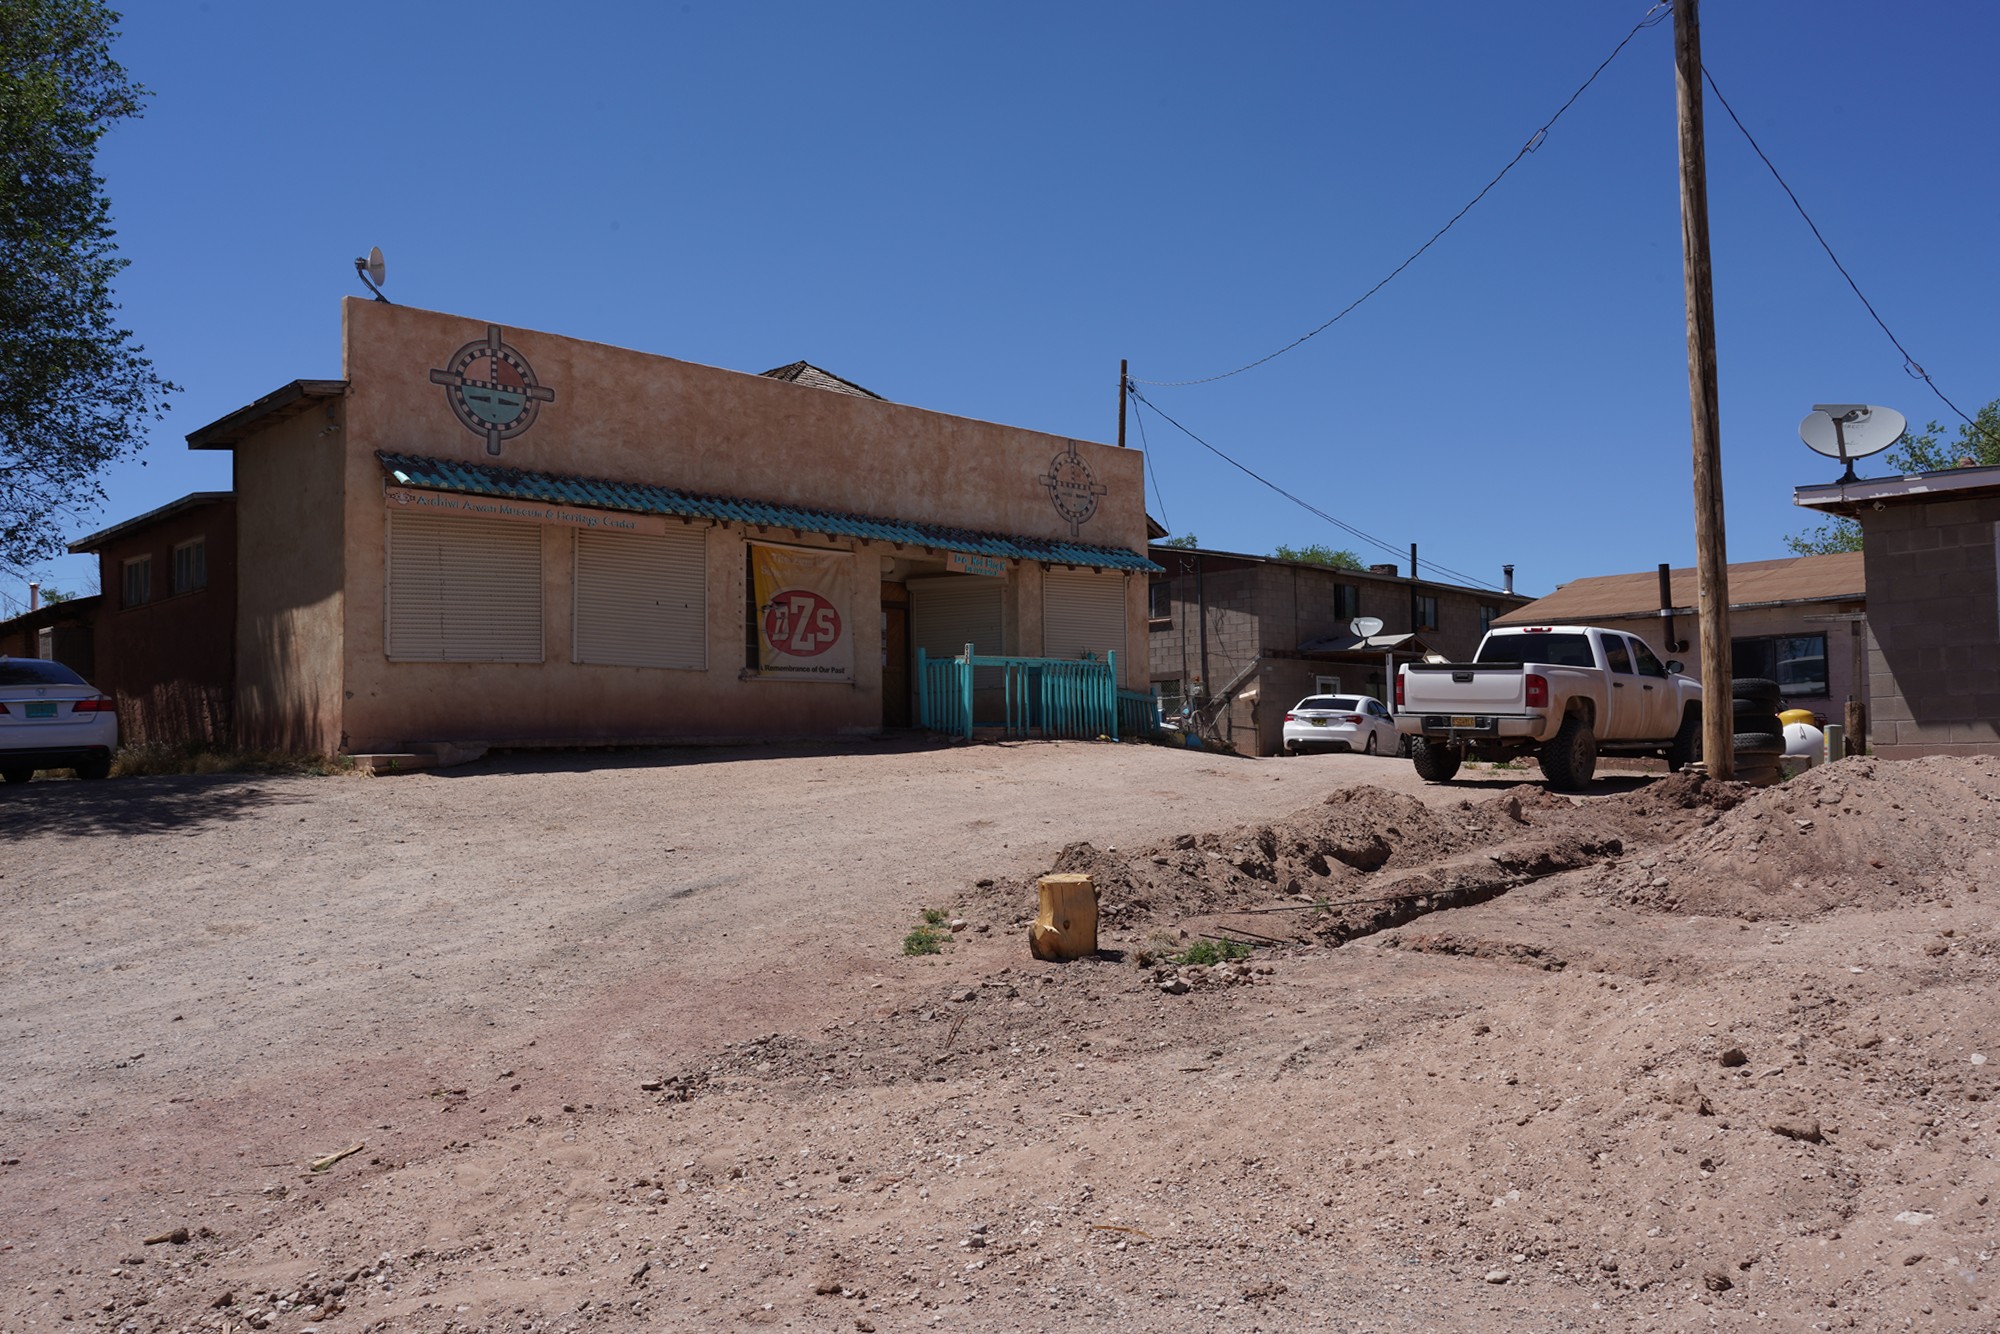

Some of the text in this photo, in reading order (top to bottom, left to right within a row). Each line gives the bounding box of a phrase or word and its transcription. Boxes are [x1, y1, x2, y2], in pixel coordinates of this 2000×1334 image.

[499, 504, 543, 518] Museum
[545, 509, 554, 519] &
[557, 511, 600, 527] Heritage
[603, 516, 636, 529] Center
[954, 554, 968, 565] Do
[971, 555, 985, 567] Not
[764, 665, 811, 673] Remembrance
